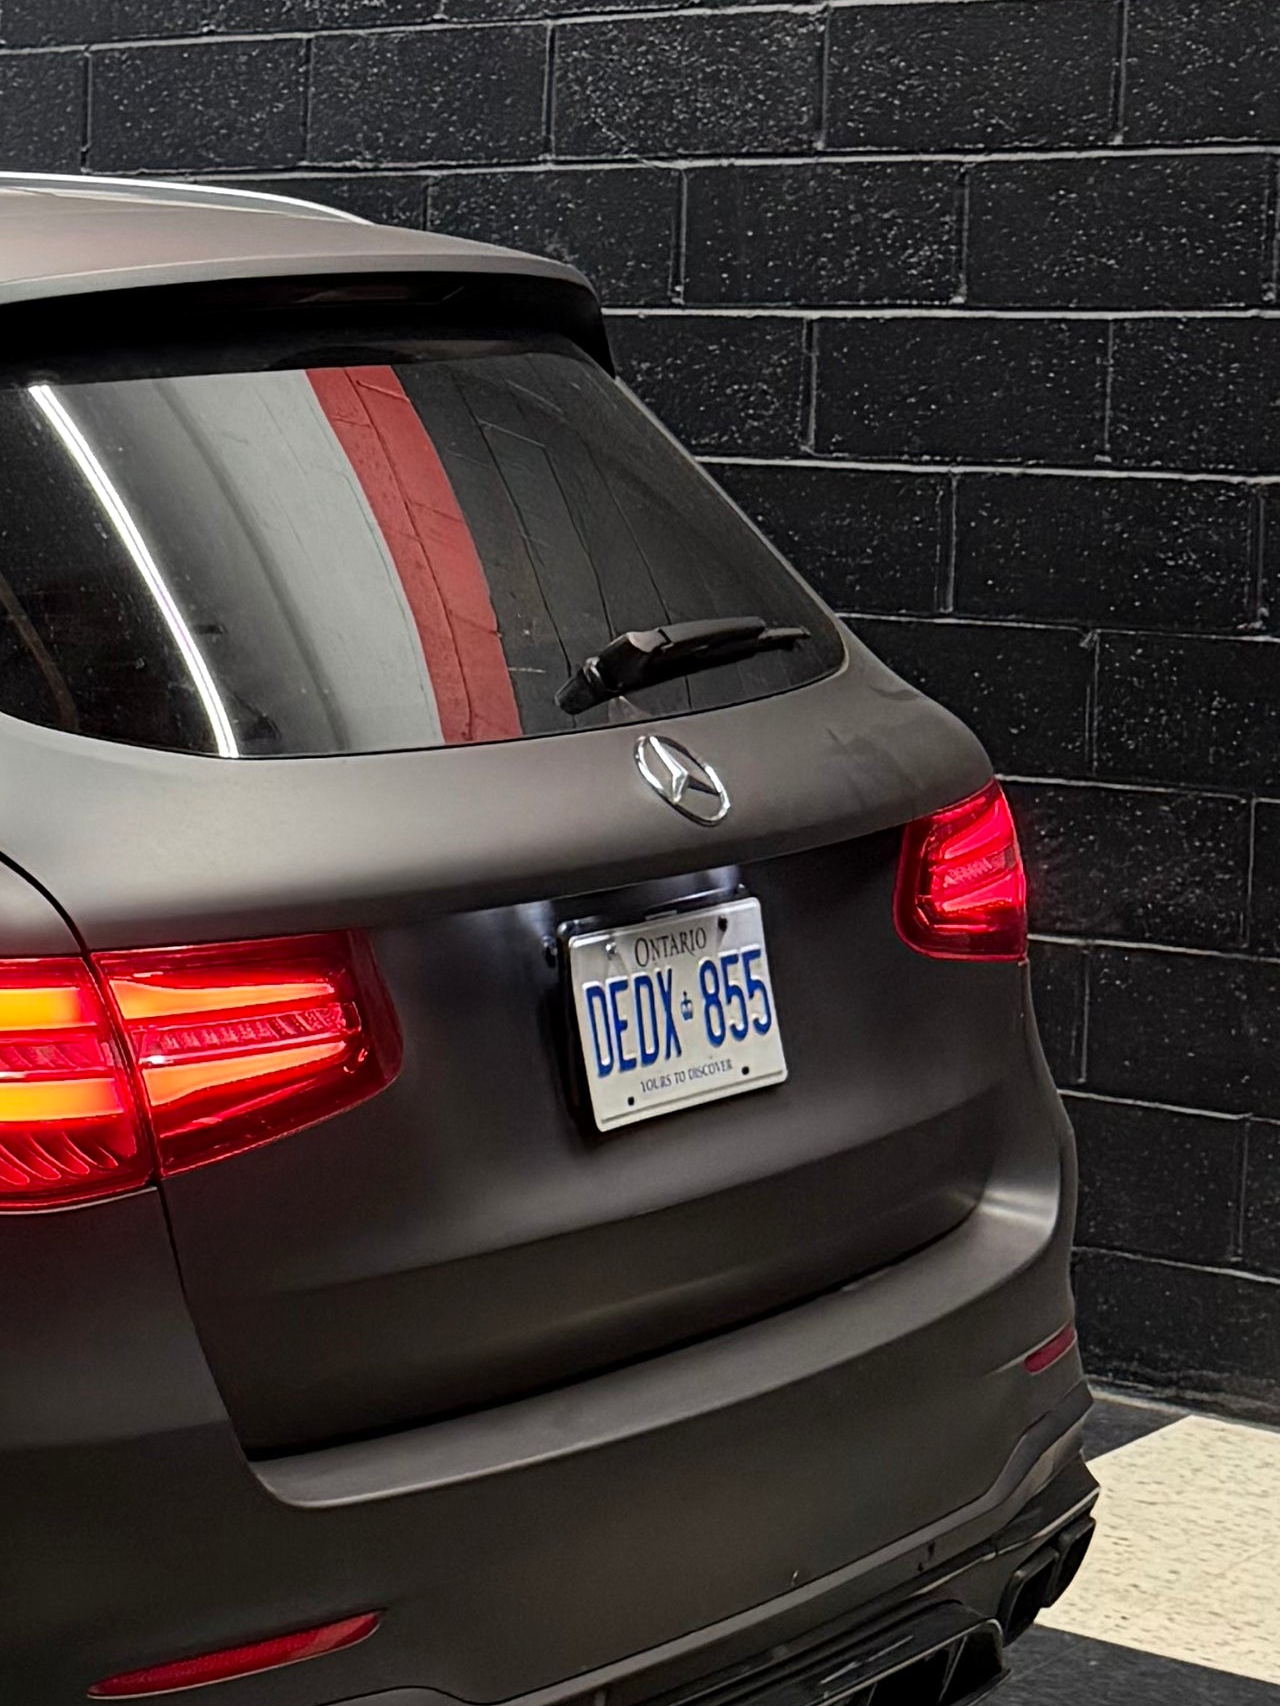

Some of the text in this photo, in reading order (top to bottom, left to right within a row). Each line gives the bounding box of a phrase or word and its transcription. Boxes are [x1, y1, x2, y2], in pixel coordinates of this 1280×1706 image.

[634, 928, 707, 966] ONTARIO
[586, 949, 772, 1077] DEDX 855
[640, 1059, 734, 1094] YOURS TO DISCOVER
